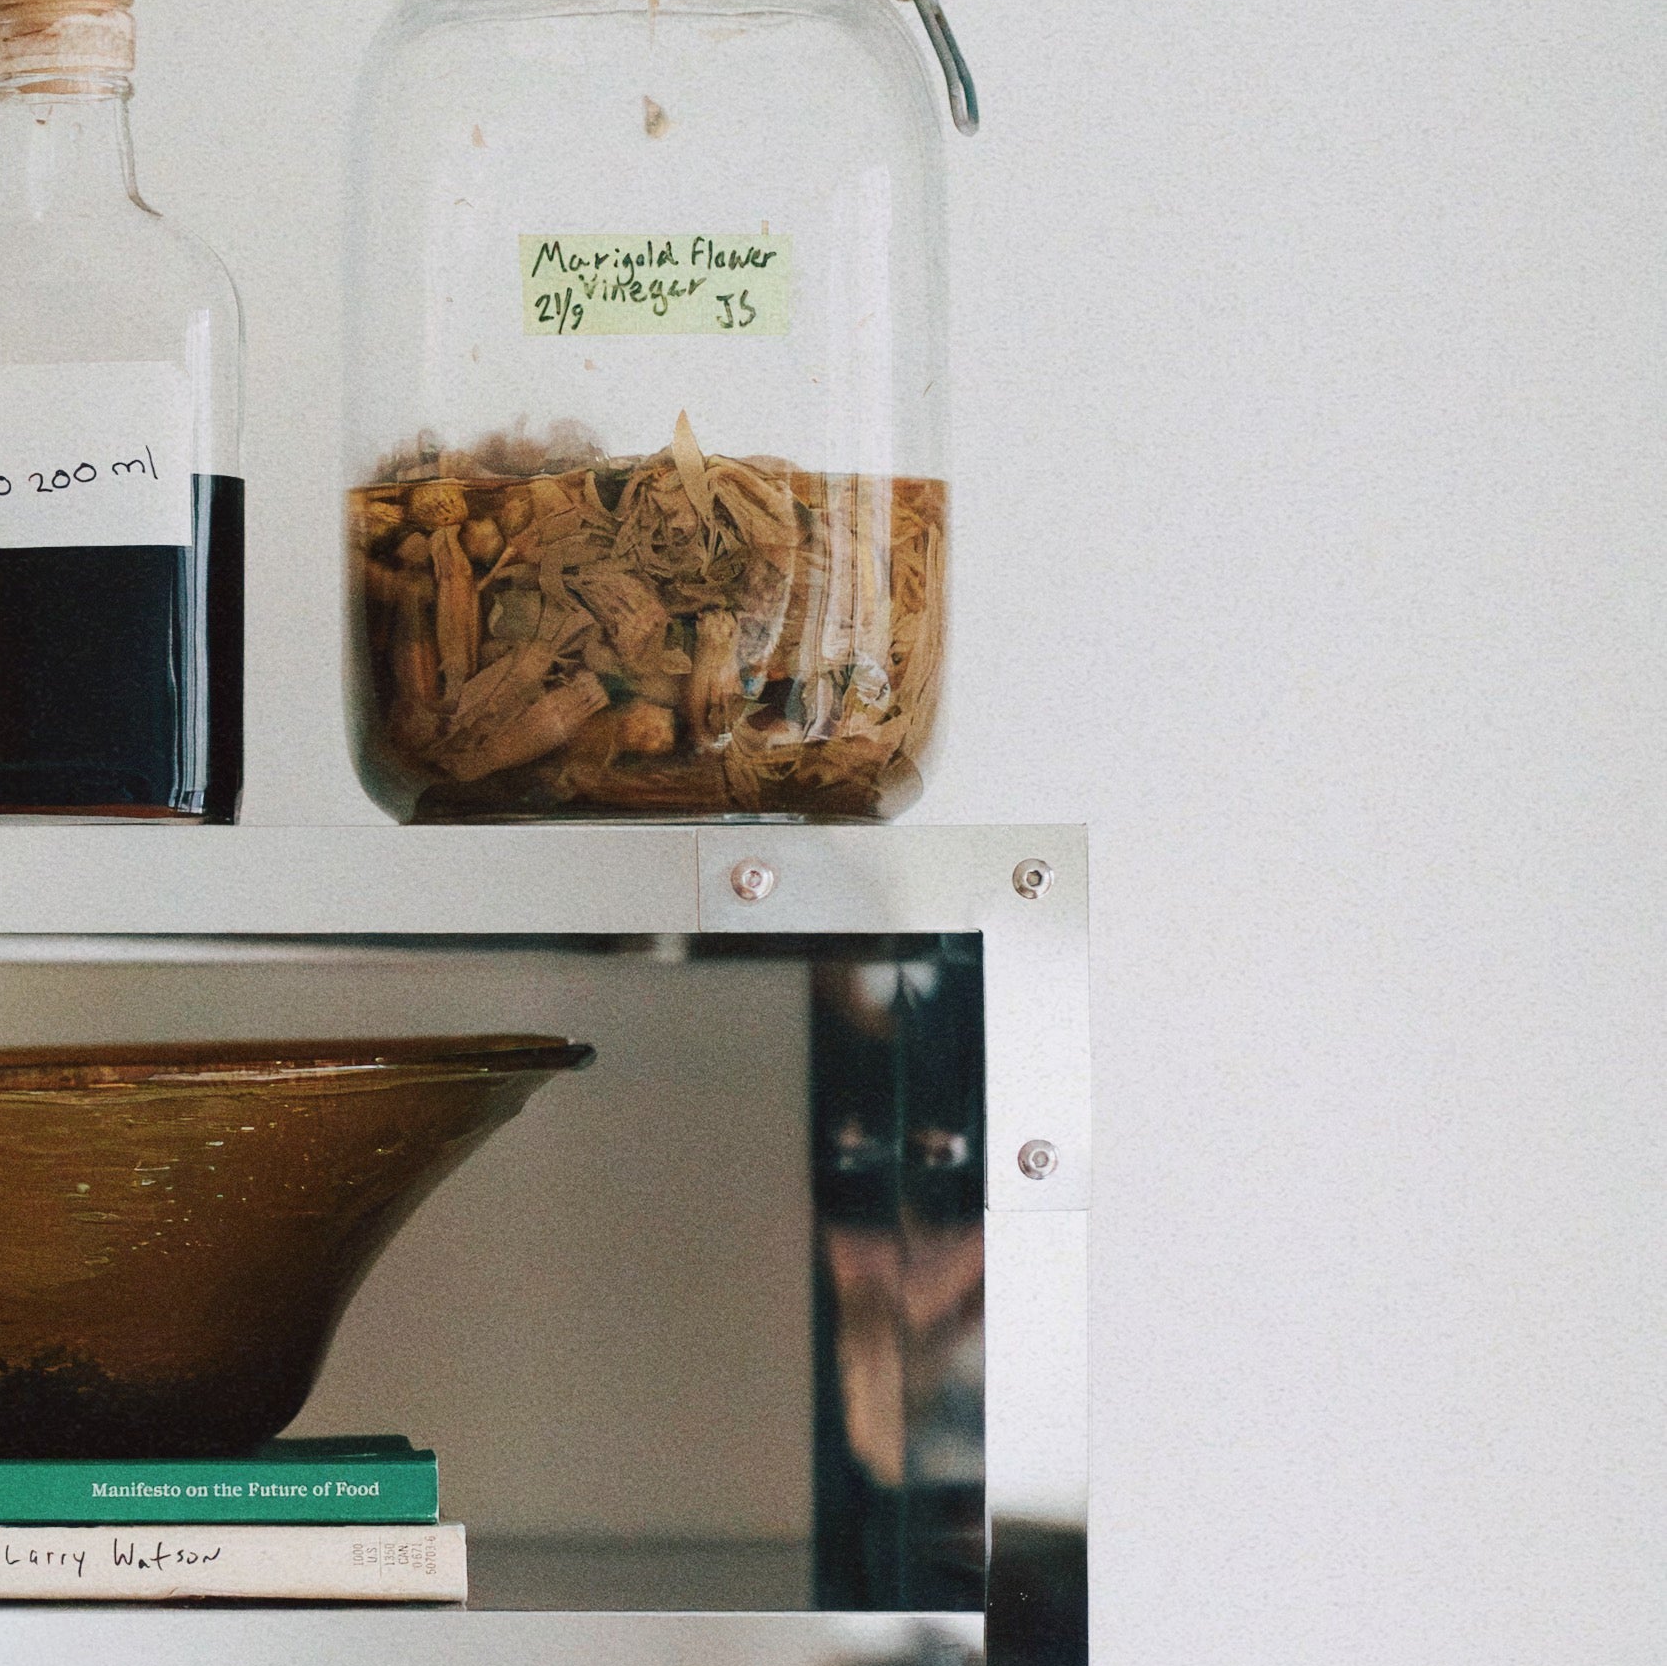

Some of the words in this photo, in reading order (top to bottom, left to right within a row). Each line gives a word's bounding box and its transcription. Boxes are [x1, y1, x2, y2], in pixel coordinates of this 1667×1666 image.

[531, 239, 679, 286] Marigold
[28, 462, 97, 493] 200
[111, 445, 159, 480] ml
[92, 1482, 181, 1498] Manifesto
[185, 1486, 209, 1498] on
[213, 1483, 243, 1498] the
[248, 1482, 308, 1498] Future
[312, 1481, 333, 1498] of
[335, 1481, 380, 1497] Food
[5, 1544, 87, 1577] Larry
[113, 1537, 221, 1570] Watson
